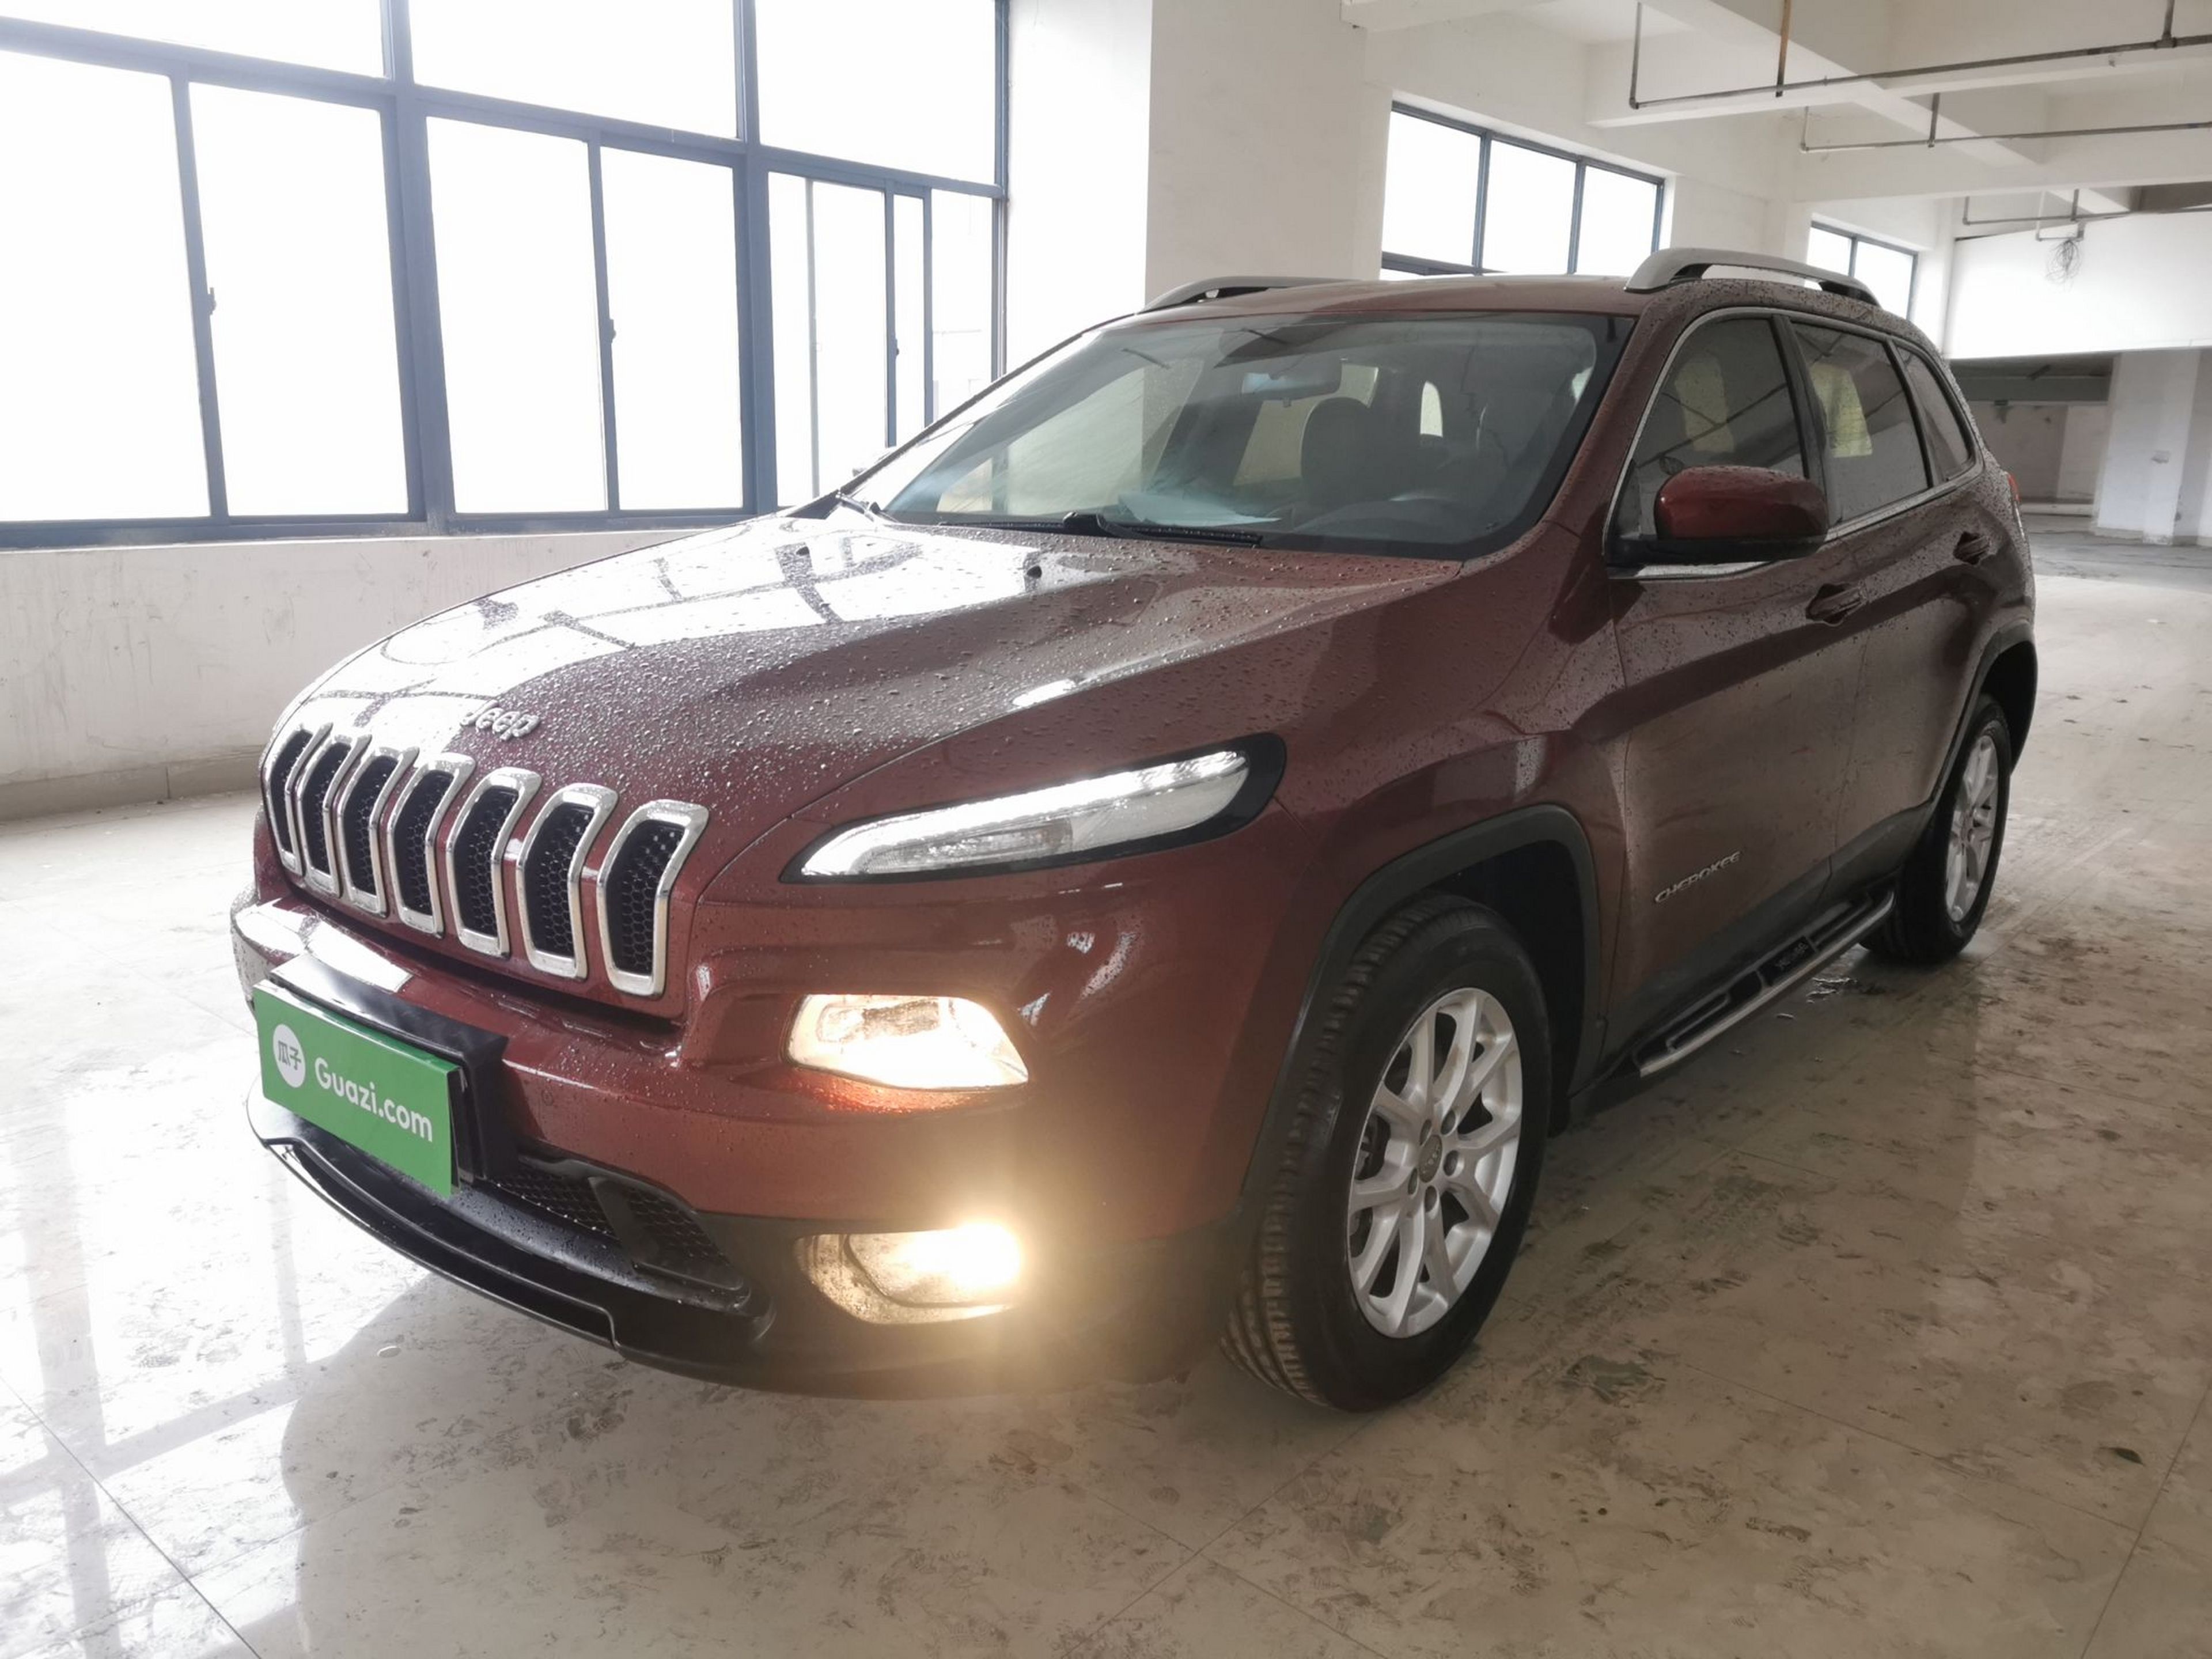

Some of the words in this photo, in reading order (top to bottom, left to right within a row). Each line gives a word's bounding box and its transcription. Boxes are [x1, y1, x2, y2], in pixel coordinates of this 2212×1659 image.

[460, 699, 540, 741] Jeep
[278, 1040, 301, 1070] 瓜子
[315, 1057, 433, 1142] Guazi.com
